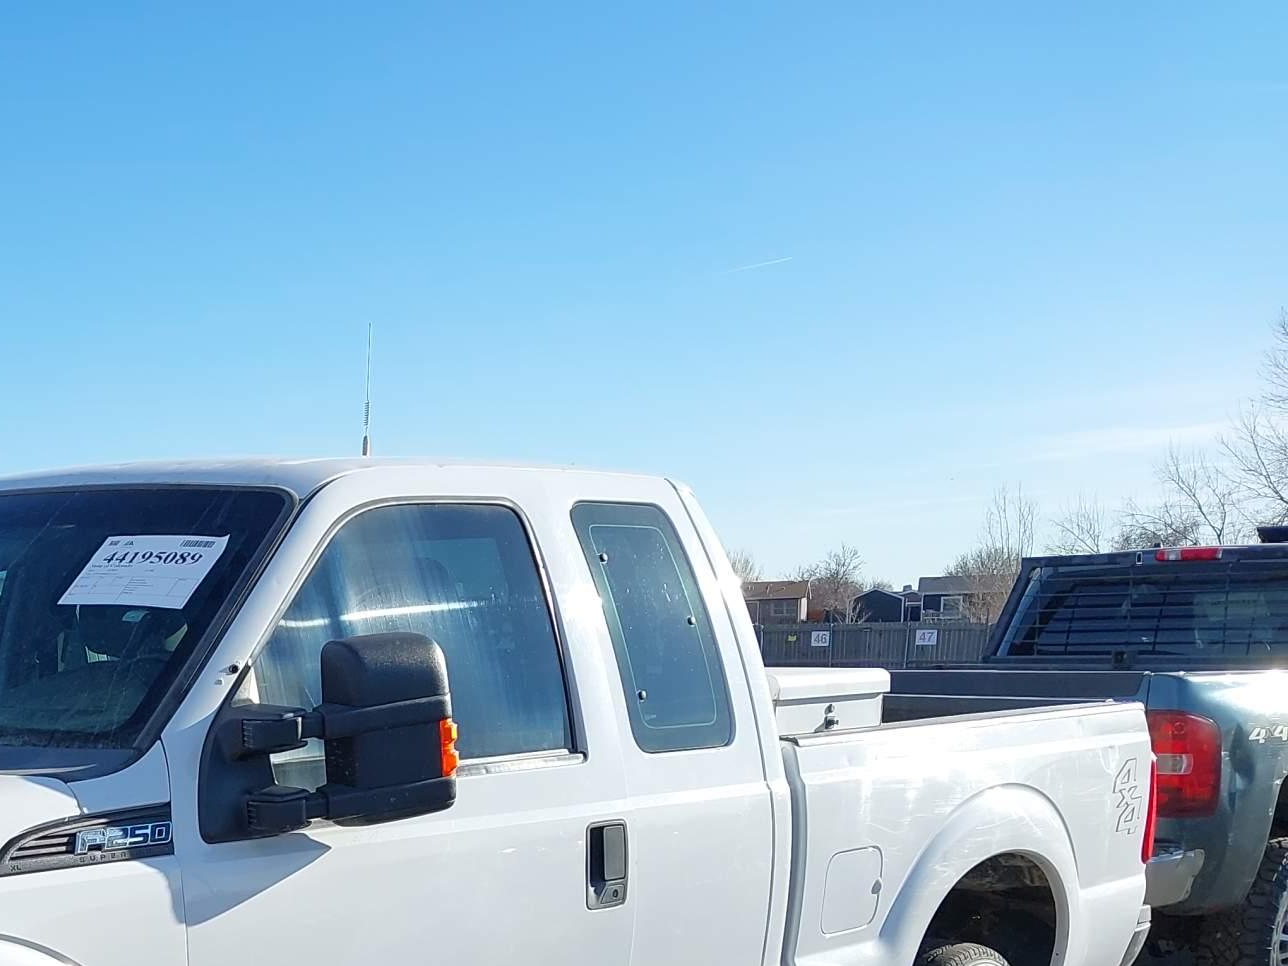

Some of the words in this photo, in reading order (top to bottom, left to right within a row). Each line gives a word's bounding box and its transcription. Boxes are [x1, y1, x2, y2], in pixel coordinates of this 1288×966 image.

[102, 550, 203, 566] 44195089
[814, 633, 827, 645] 46
[918, 631, 934, 643] 47
